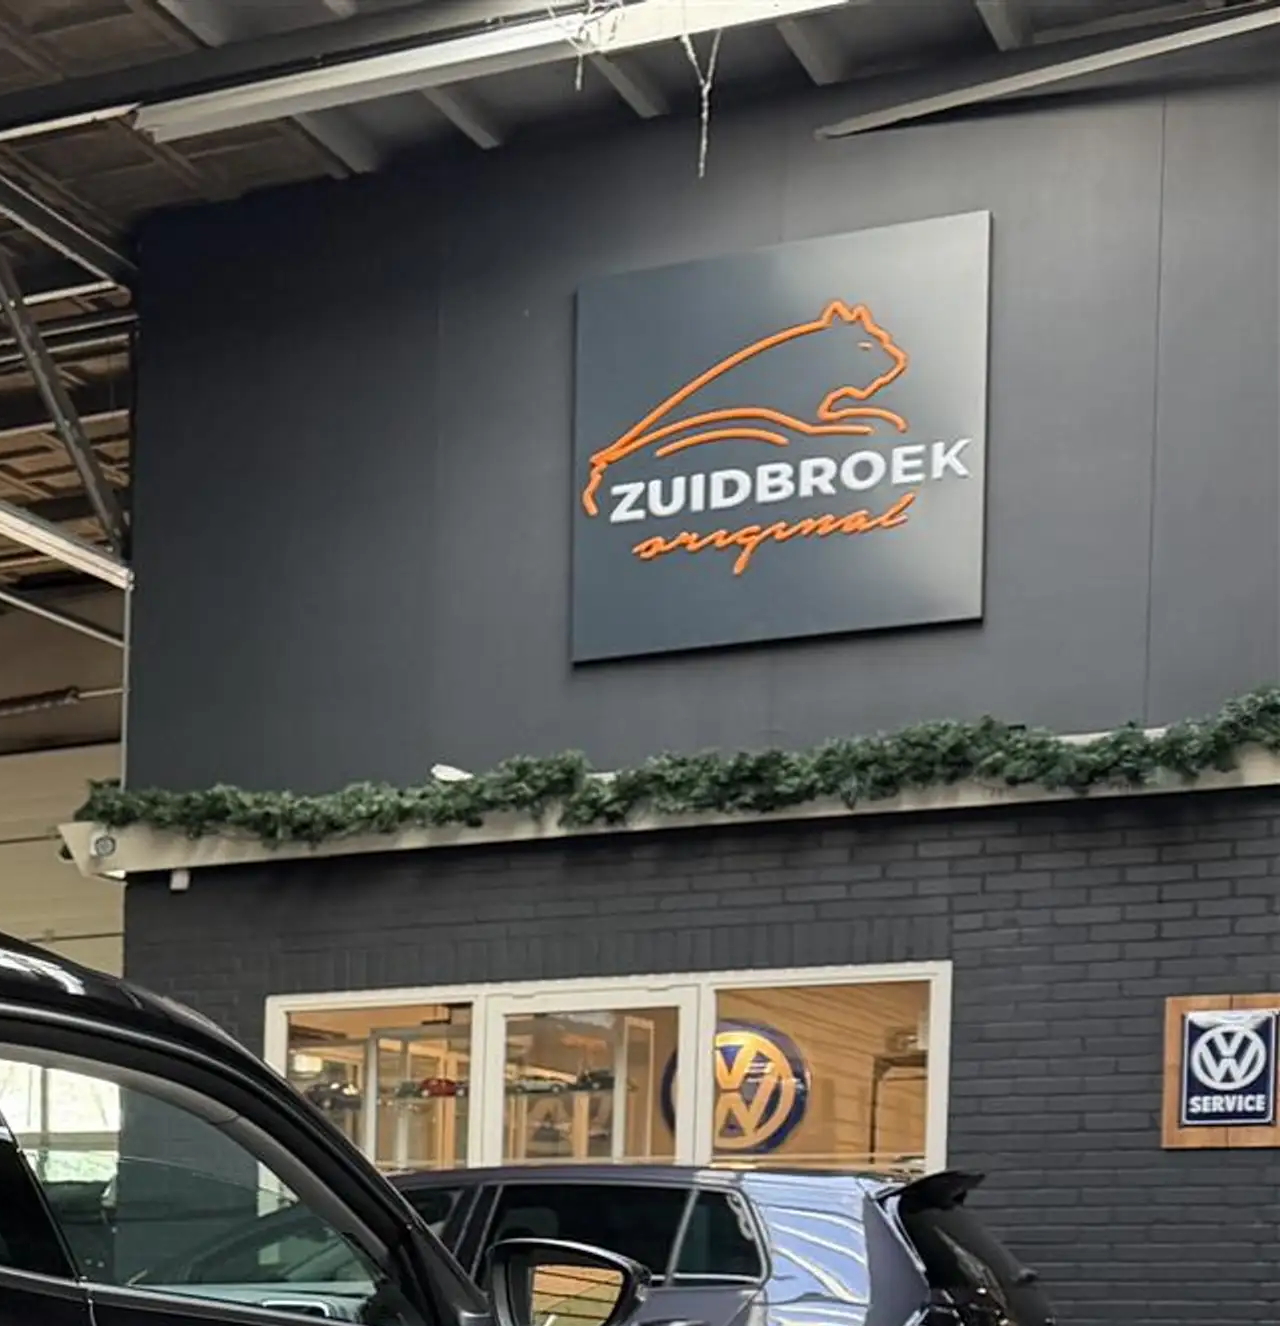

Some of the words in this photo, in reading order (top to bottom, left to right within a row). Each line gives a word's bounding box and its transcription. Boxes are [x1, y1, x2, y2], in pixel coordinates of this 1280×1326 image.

[609, 438, 972, 524] ZUIDBROEK
[632, 490, 915, 577] original
[1188, 1094, 1266, 1113] SERVICE
